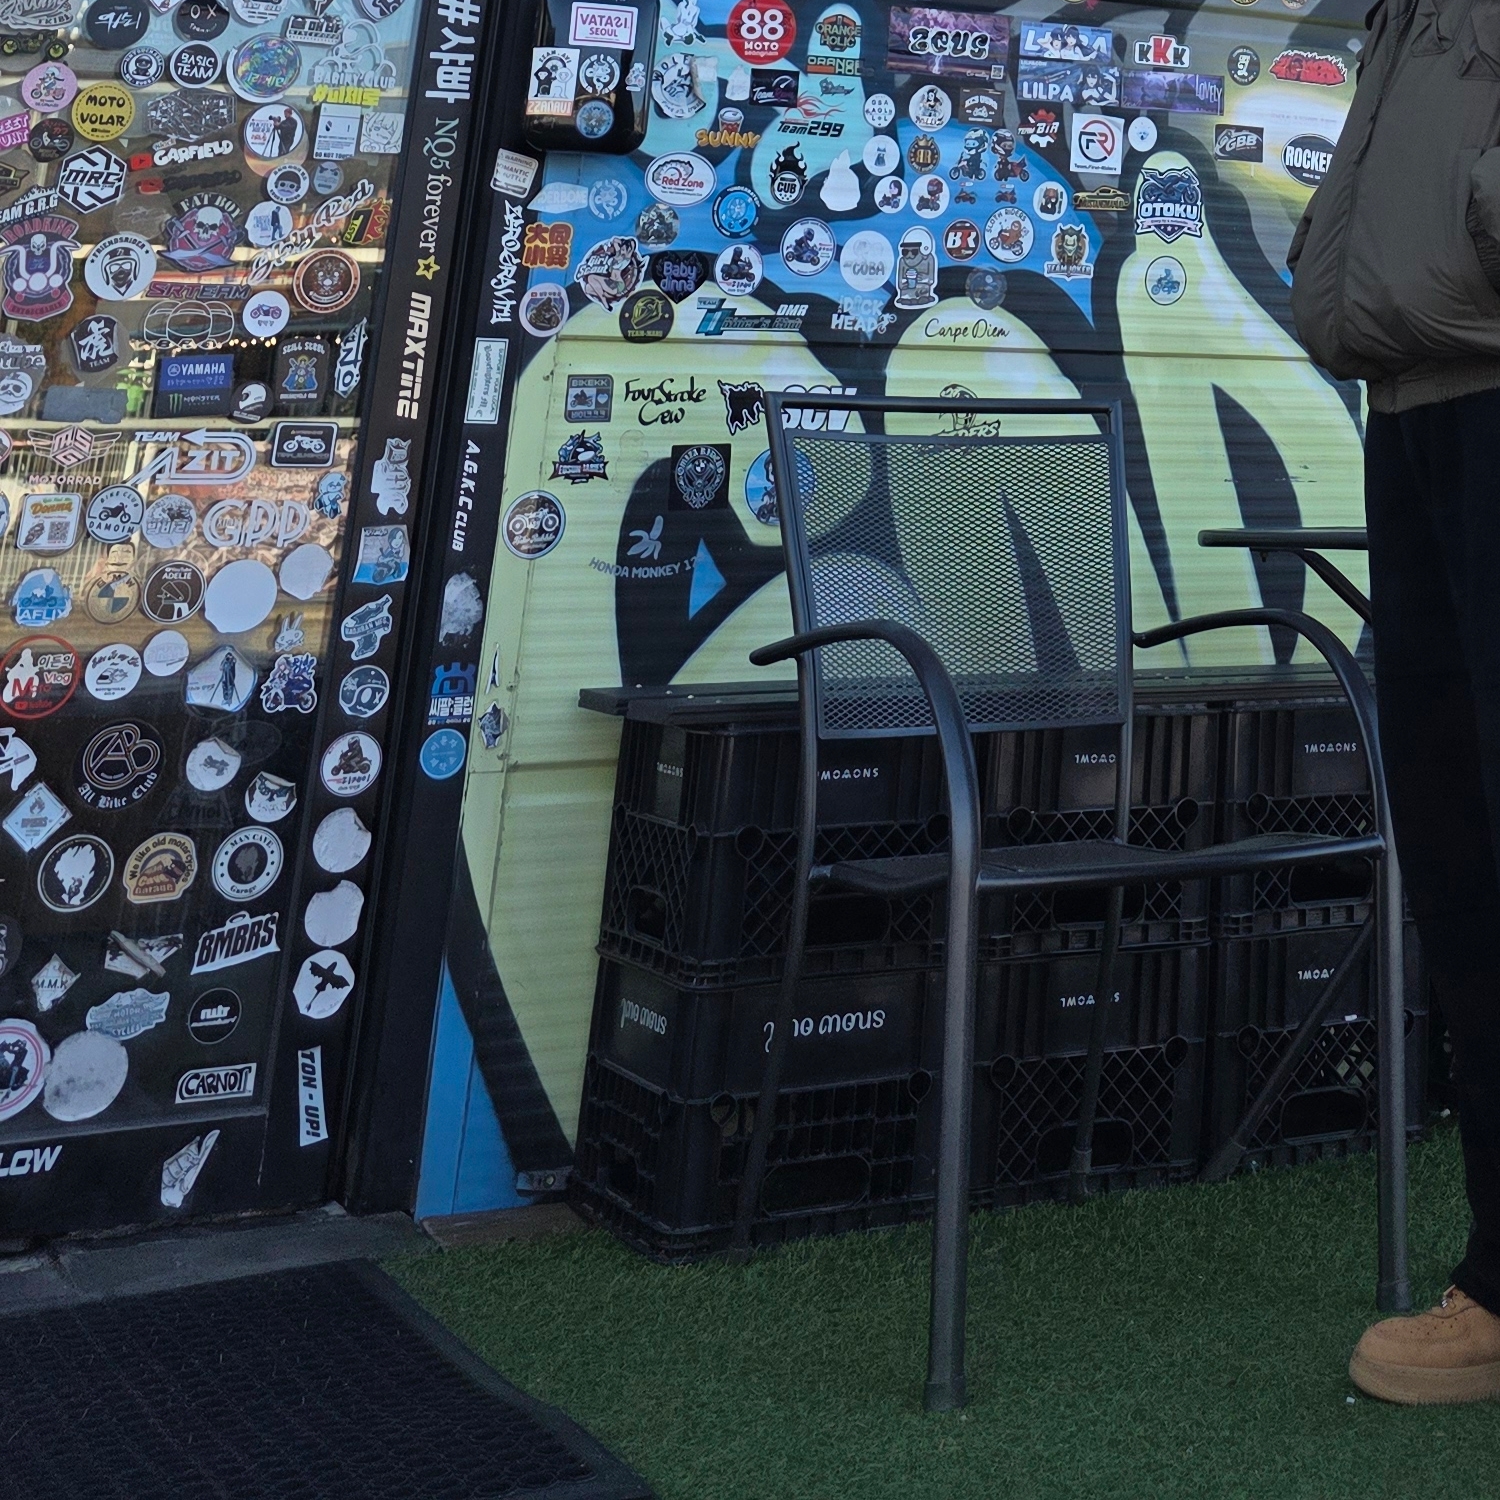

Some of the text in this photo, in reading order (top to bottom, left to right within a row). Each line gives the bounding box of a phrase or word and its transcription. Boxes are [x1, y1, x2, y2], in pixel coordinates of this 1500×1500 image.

[589, 26, 619, 38] SEOUL
[741, 8, 784, 40] 88
[815, 22, 861, 38] ORANGE
[744, 40, 779, 51] MOTO
[908, 27, 990, 60] ZEUS
[1136, 37, 1188, 67] KKK
[181, 52, 215, 68] BASIC
[176, 62, 216, 80] TEAM
[1022, 80, 1074, 103] LILPA
[85, 94, 126, 110] MOTO
[80, 112, 126, 128] VOLAR
[696, 128, 761, 148] SUNNY
[153, 138, 235, 167] GARFIELD
[661, 174, 704, 189] Red Zone
[776, 180, 797, 195] CUB
[418, 172, 453, 254] forever
[1140, 201, 1200, 221] OTOKU
[662, 260, 698, 281] Baby
[924, 317, 1010, 344] Carpe Diem
[182, 362, 227, 376] YAMAHA
[638, 401, 686, 427] Crew
[134, 431, 182, 443] TEAM
[28, 473, 102, 487] MOTORRAD
[88, 519, 136, 535] DAMOIM
[162, 570, 193, 581] ADELIE
[44, 670, 73, 685] Vlog
[199, 917, 279, 964] BMBRS
[183, 1065, 253, 1098] CARNOT
